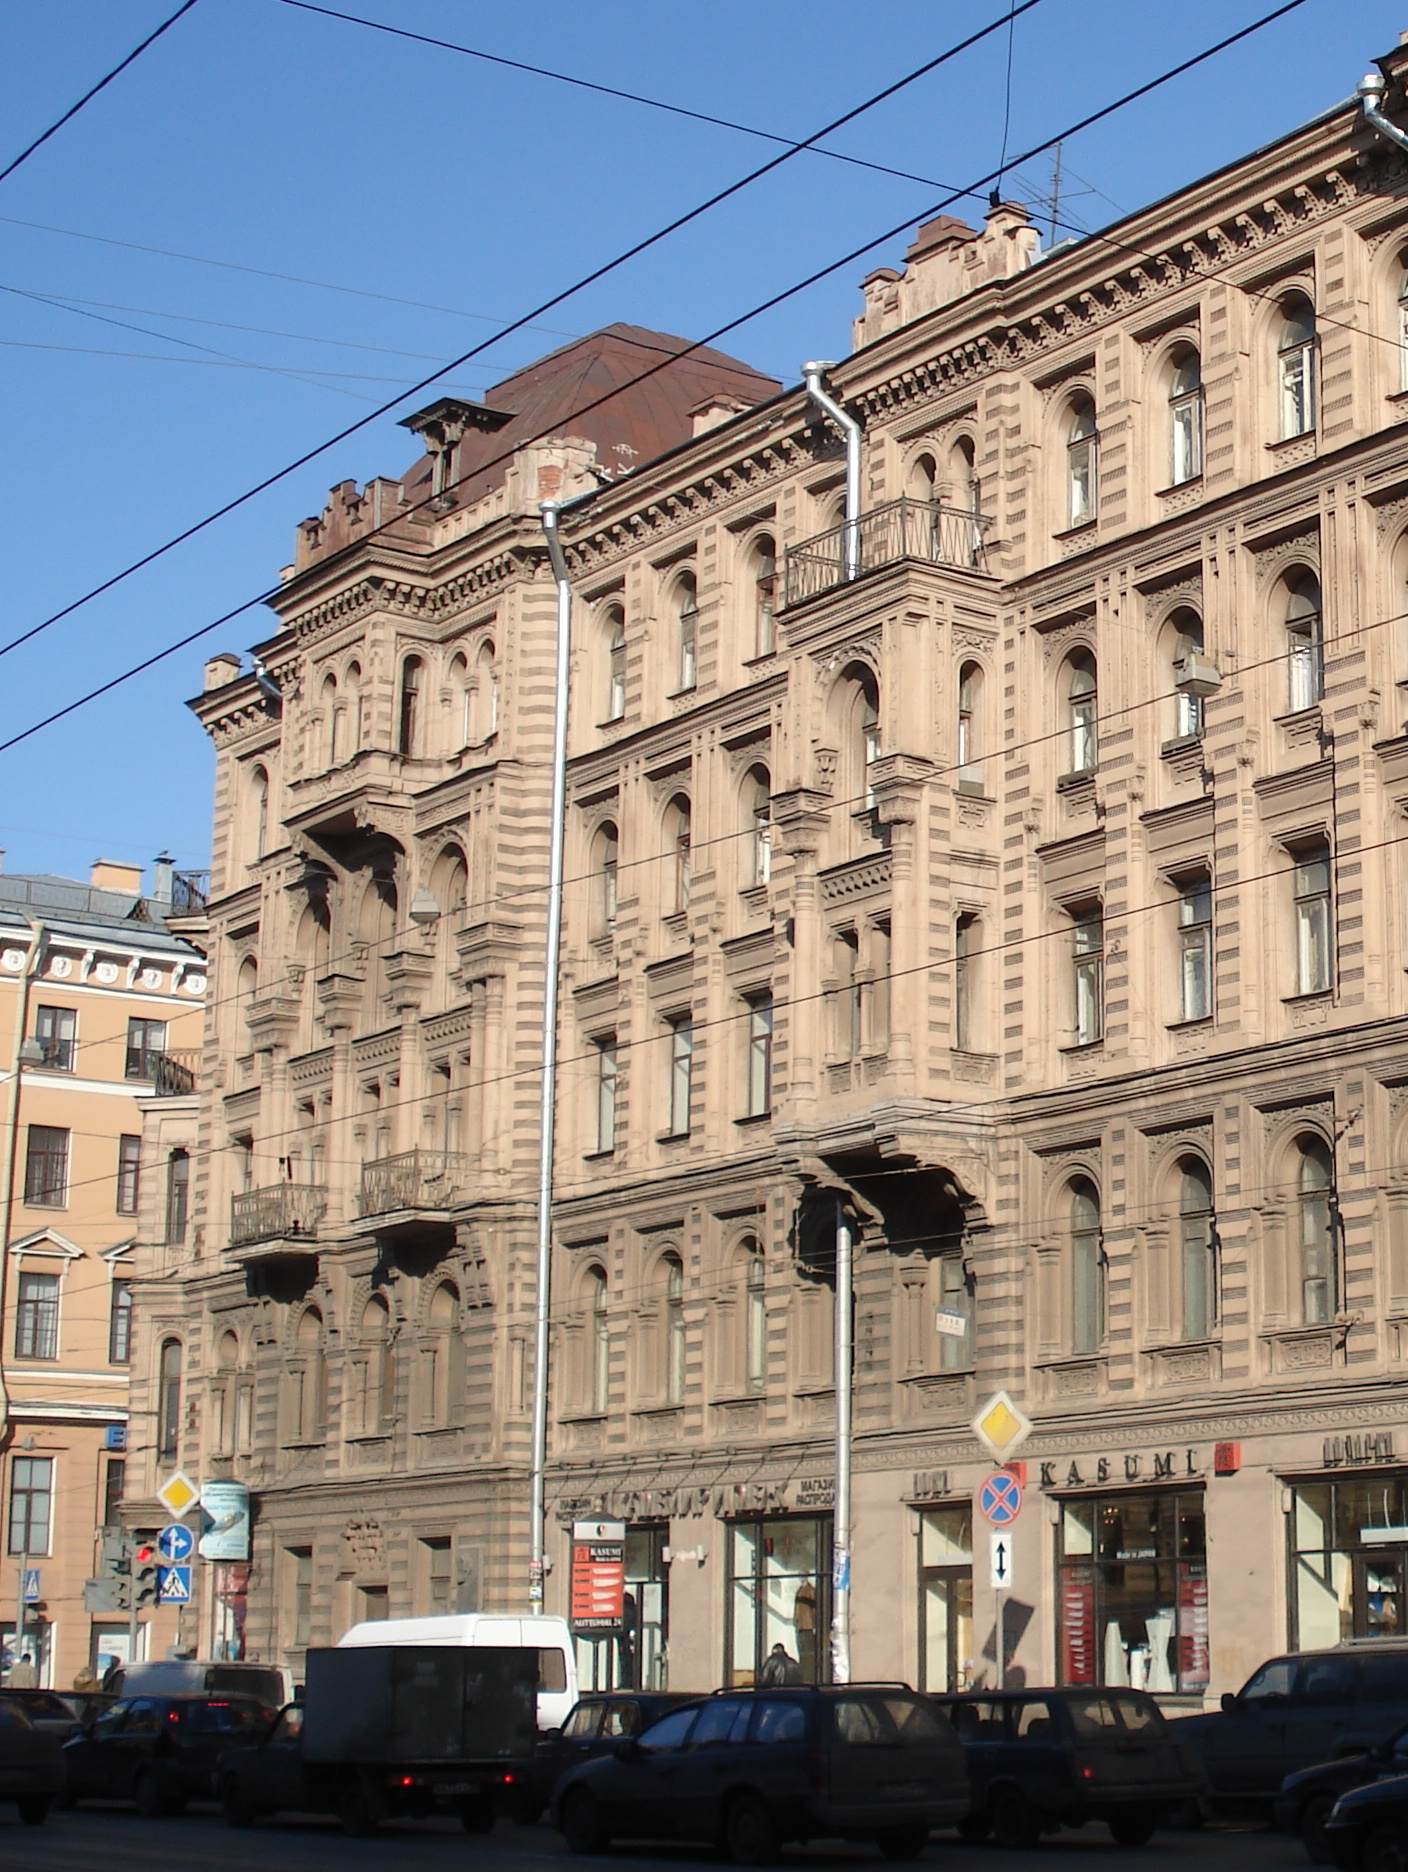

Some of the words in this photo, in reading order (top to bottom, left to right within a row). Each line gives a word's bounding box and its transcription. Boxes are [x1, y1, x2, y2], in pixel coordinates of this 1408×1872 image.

[1039, 1449, 1198, 1488] KASUMI
[800, 1479, 836, 1491] МАГАЗИ
[796, 1492, 836, 1506] РАСПРОДА
[590, 1547, 621, 1556] KASUMI
